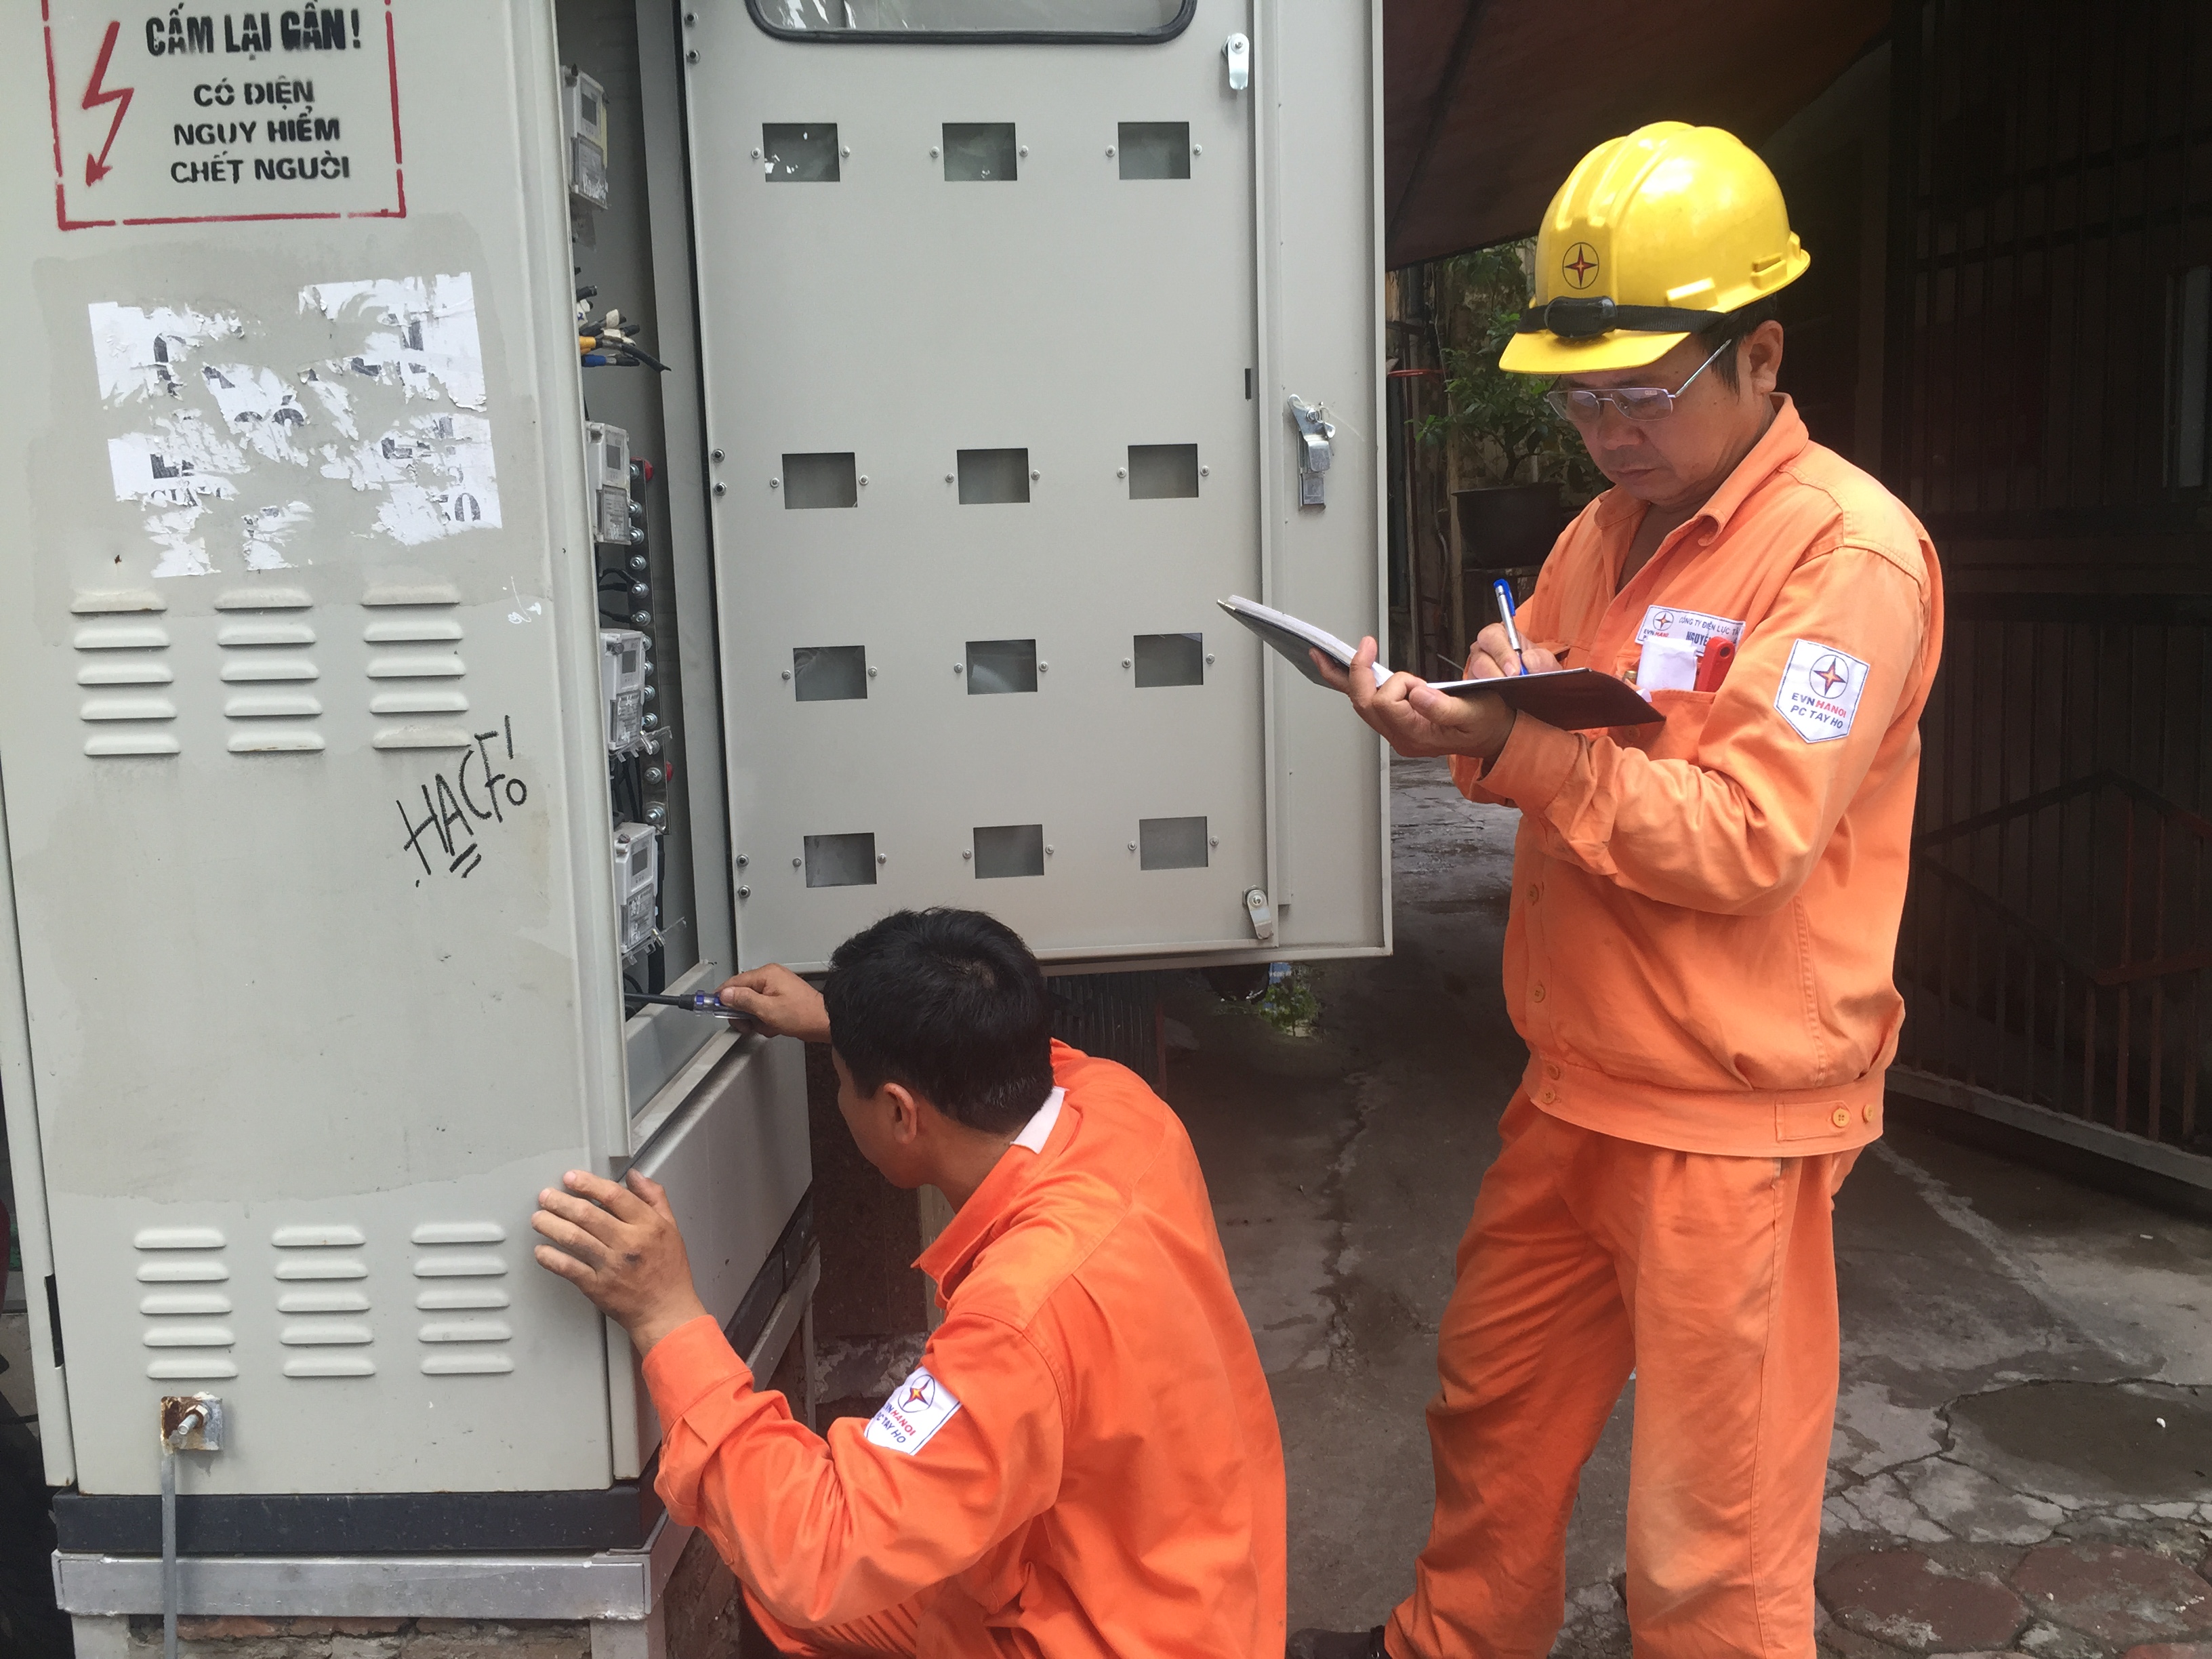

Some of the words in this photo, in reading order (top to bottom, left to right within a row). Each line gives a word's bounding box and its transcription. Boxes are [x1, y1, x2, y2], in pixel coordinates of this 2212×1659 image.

[145, 1, 214, 56] CẤM
[224, 12, 271, 61] LẠI
[193, 77, 235, 107] CÓ
[173, 121, 257, 146] NGUY
[267, 105, 340, 143] HIỂM
[170, 150, 244, 184] CHẾT
[1790, 705, 1807, 716] PC
[1809, 710, 1830, 723] TAY
[1830, 717, 1843, 729] HO
[881, 1416, 895, 1430] TAY
[890, 1429, 906, 1443] HO
